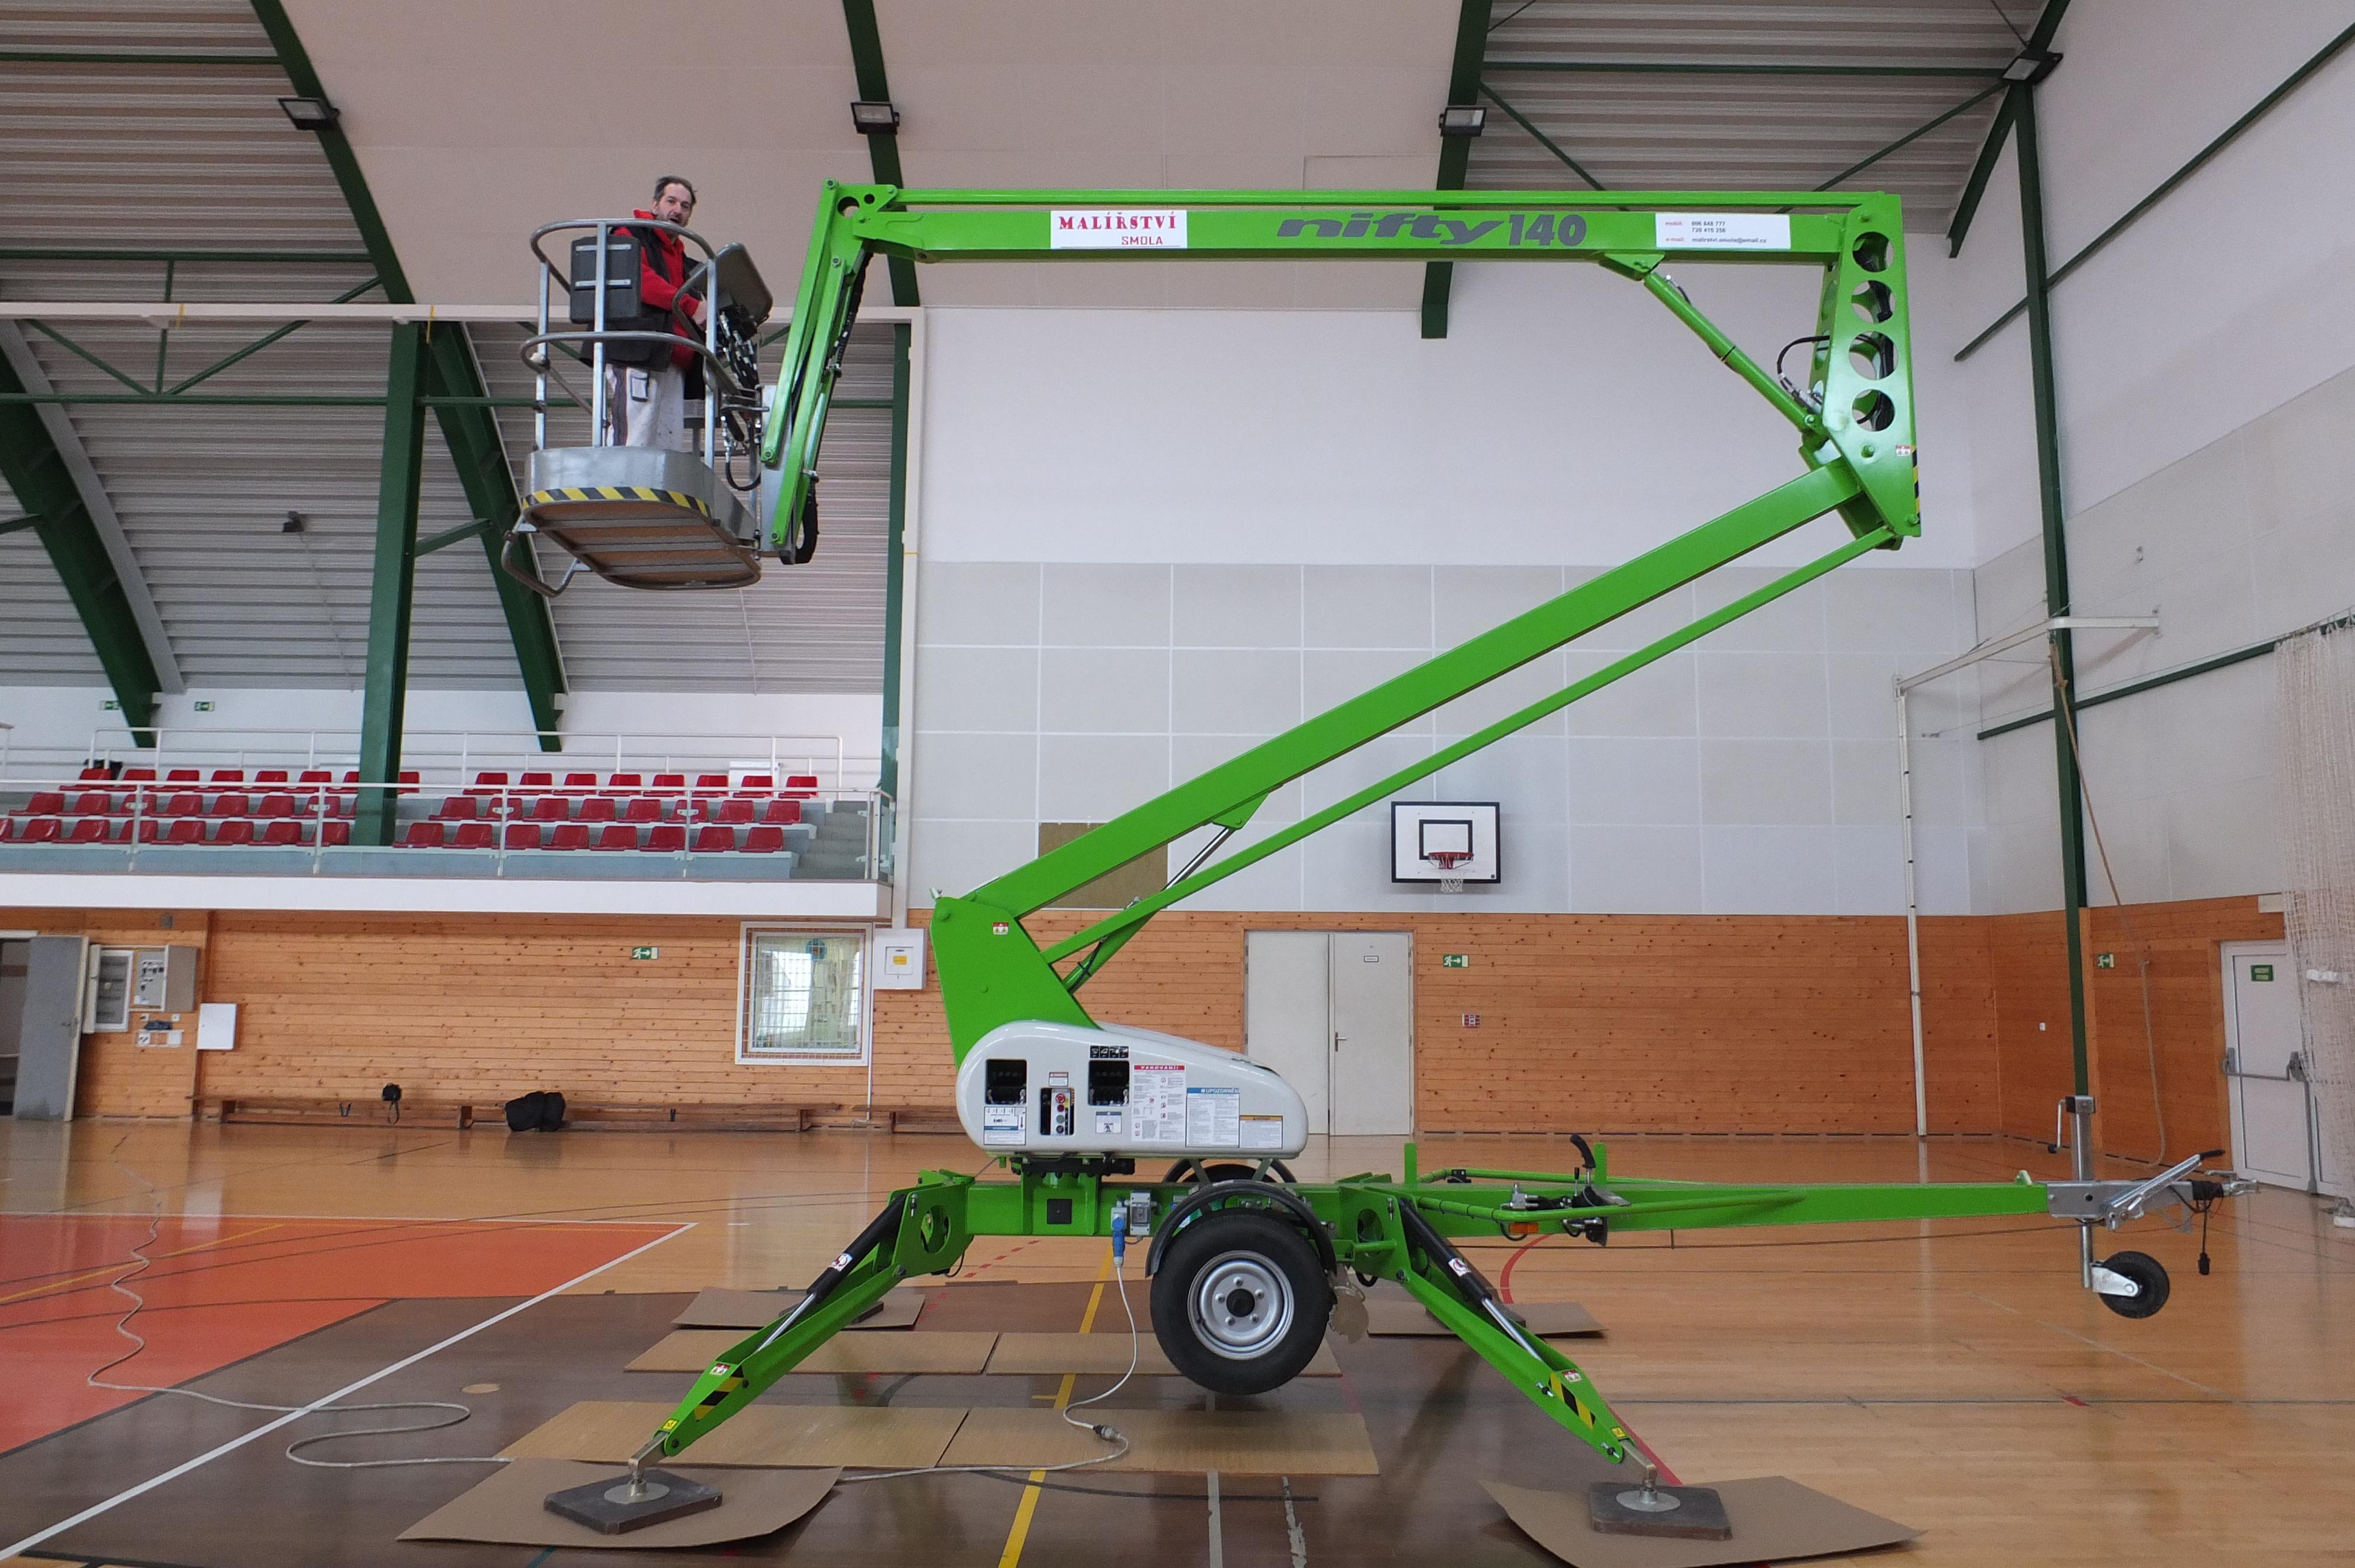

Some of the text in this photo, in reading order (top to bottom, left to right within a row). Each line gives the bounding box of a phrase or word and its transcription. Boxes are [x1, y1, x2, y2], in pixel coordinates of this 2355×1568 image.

[1059, 211, 1177, 230] MALÍŘSTVÍ
[1278, 212, 1587, 247] nifty 140
[1121, 236, 1163, 245] SMOLA
